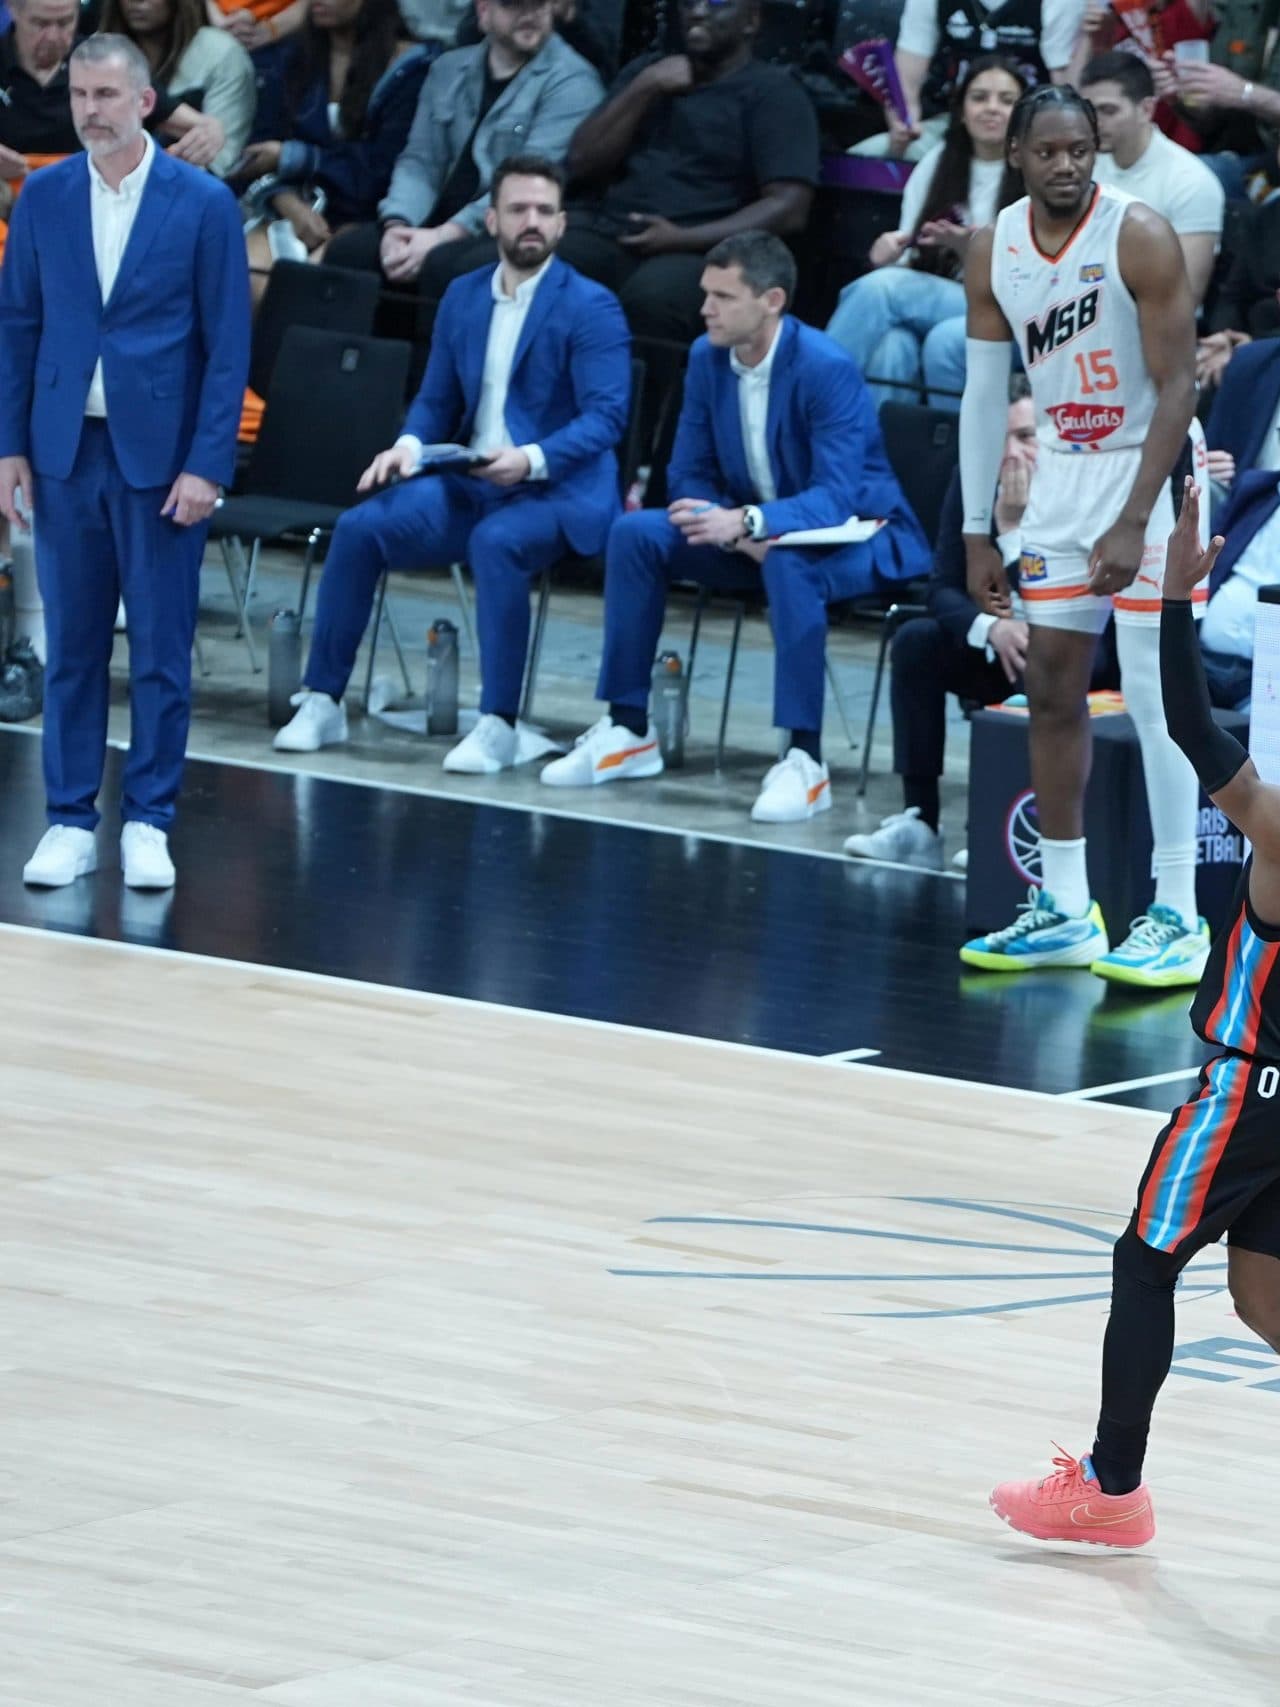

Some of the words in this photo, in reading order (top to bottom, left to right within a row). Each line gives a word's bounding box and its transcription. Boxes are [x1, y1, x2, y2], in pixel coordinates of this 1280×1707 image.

[1026, 288, 1100, 365] MSB
[1074, 349, 1119, 395] 15
[1056, 407, 1123, 431] Gaulois
[1196, 806, 1228, 835] RIS
[1257, 1066, 1280, 1099] 0
